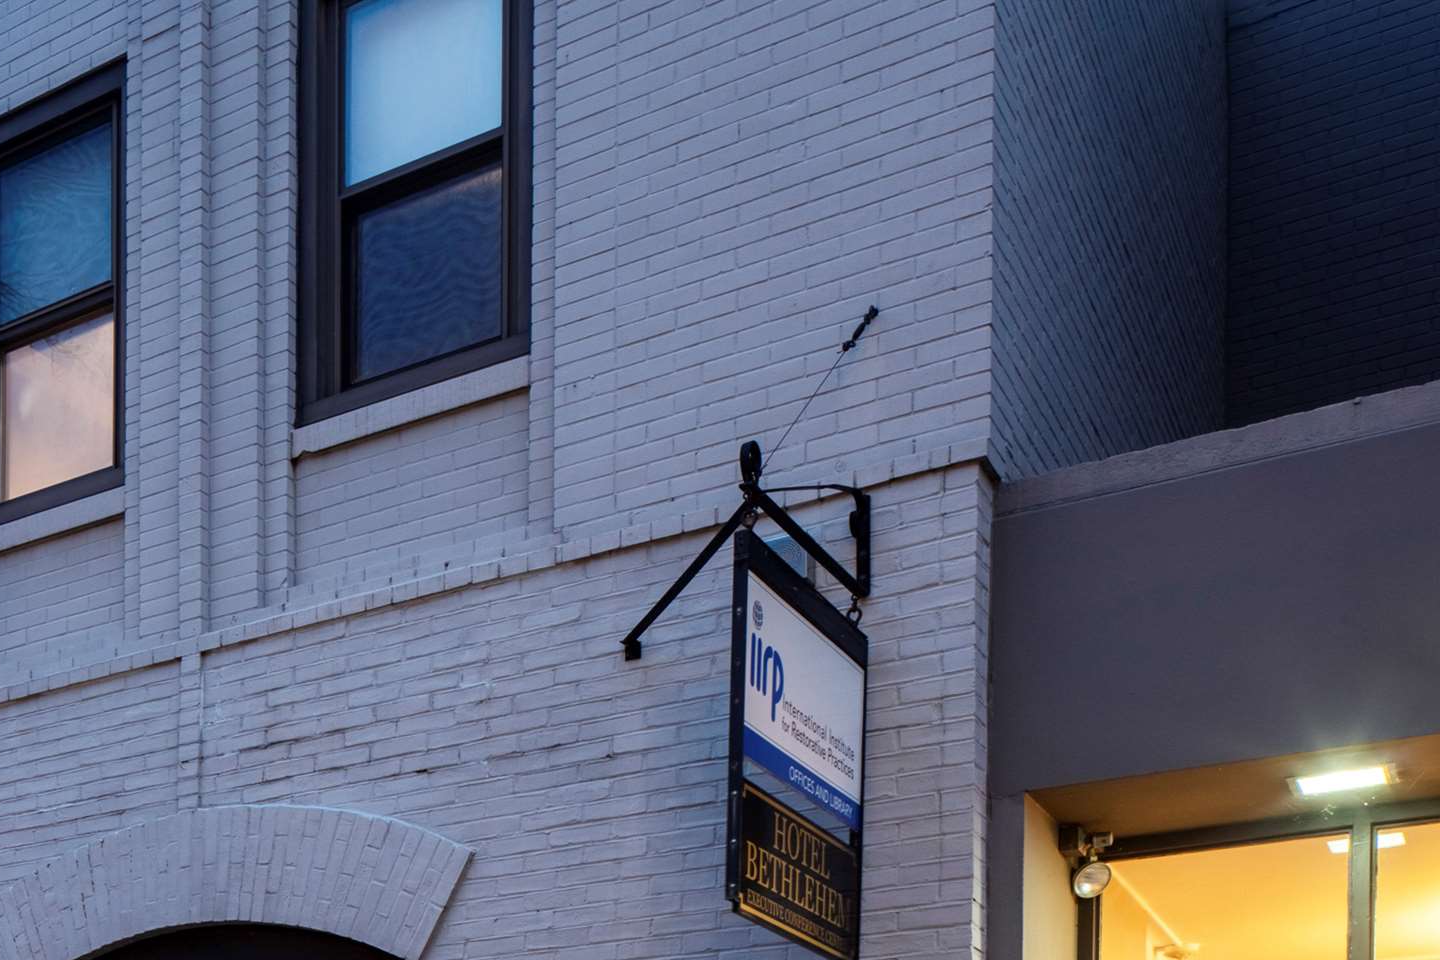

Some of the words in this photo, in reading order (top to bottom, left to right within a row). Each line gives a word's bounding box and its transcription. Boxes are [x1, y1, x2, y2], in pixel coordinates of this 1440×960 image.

[781, 716, 791, 736] for
[791, 721, 826, 761] Restorative
[827, 747, 855, 780] Practices
[783, 694, 828, 741] International
[829, 725, 855, 761] Institute
[788, 766, 816, 795] OFFICES
[816, 783, 829, 805] AND
[830, 794, 853, 818] LIBRARY
[774, 812, 830, 880] HOTEL
[747, 888, 785, 920] EXECUTIVE
[785, 908, 825, 943] CONFERENCE
